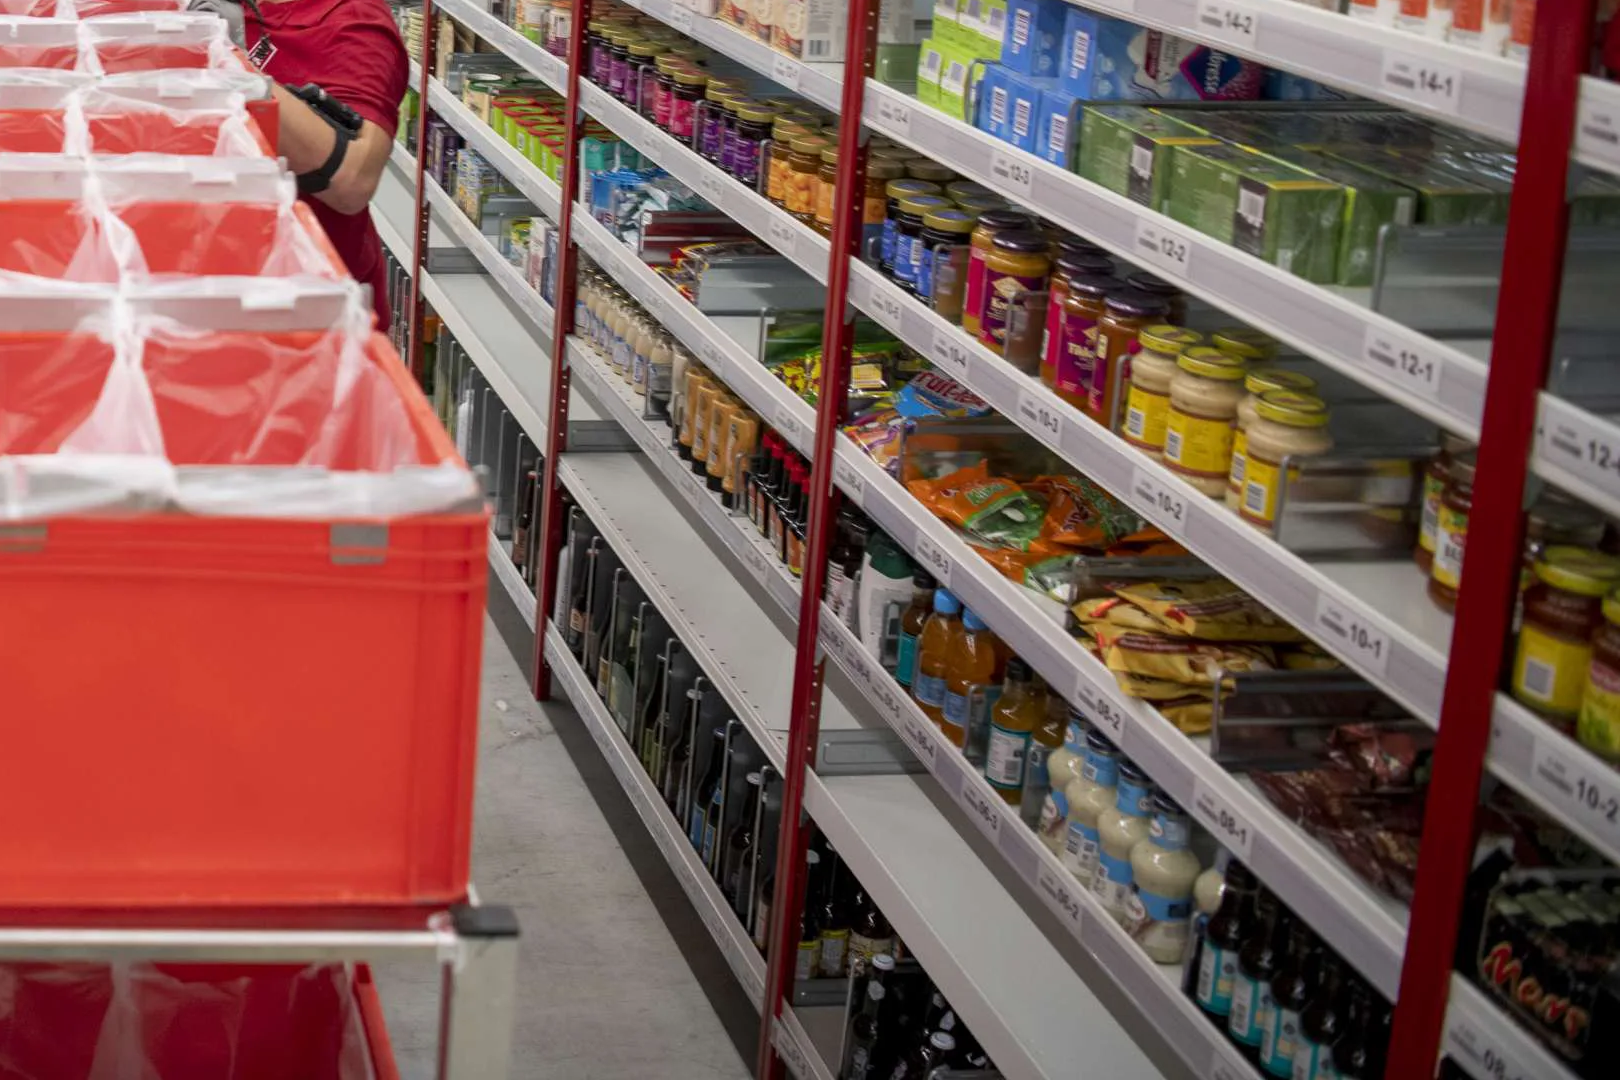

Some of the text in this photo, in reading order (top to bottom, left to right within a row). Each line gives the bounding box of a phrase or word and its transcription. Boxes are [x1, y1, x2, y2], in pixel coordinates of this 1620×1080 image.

[1225, 11, 1252, 34] 14-2
[1418, 69, 1452, 97] 14-1
[1009, 162, 1029, 185] 12-3
[1159, 237, 1186, 262] 12-2
[1398, 351, 1432, 382] 12-1
[1038, 408, 1058, 434] 10-3
[1588, 439, 1620, 476] 12-
[1156, 490, 1181, 520] 10-2
[1349, 624, 1381, 659] 10-1
[1096, 698, 1120, 730] 08-2
[1577, 777, 1618, 824] 10-2
[1218, 816, 1246, 846] 08-1
[1057, 886, 1079, 919] 06-2
[1483, 940, 1590, 1040] Mars
